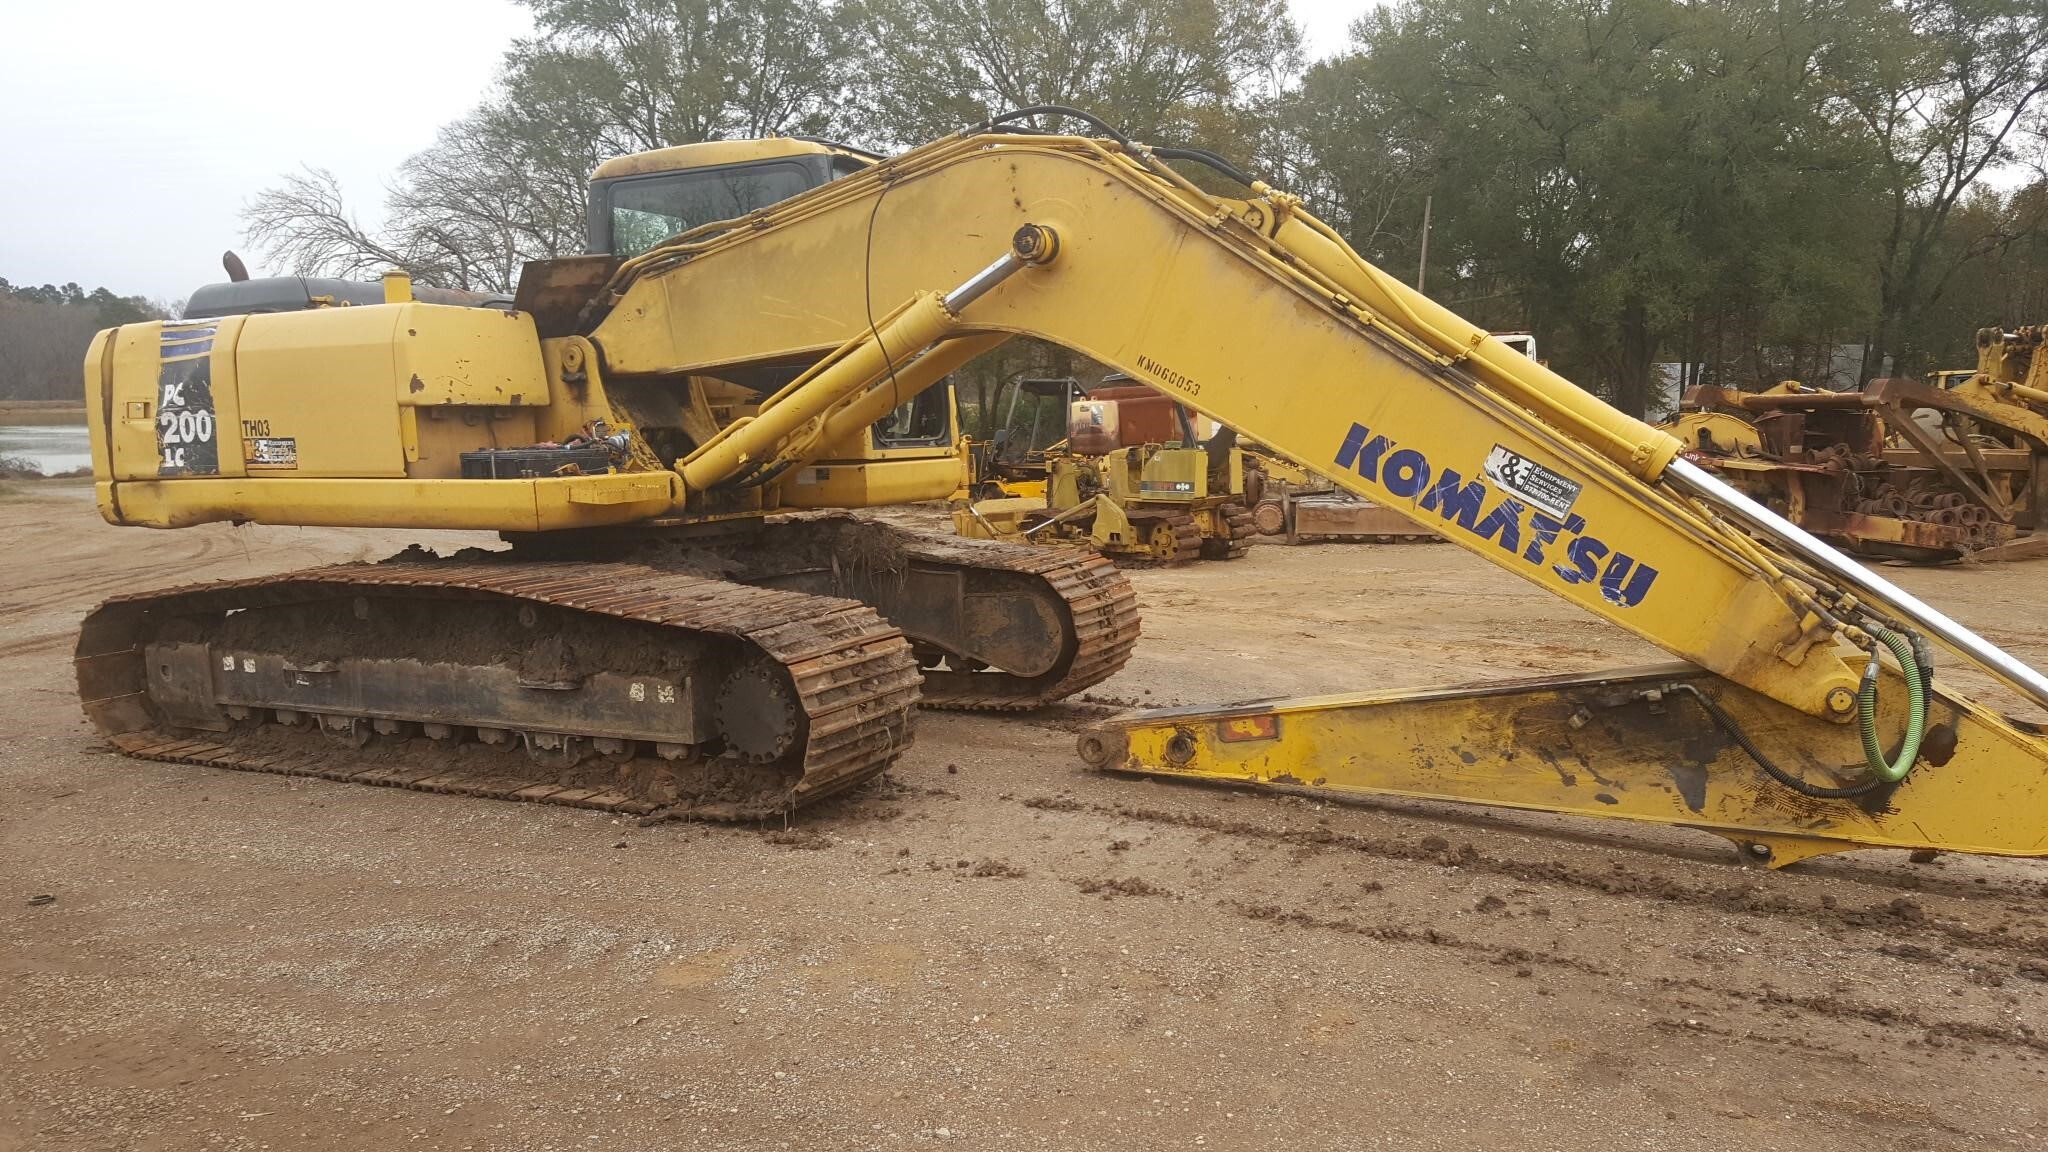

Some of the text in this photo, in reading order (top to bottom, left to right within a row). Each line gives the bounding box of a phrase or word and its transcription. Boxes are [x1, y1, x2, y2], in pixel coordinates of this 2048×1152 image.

[162, 382, 185, 407] PC
[160, 409, 212, 444] 200
[242, 419, 271, 437] TH03
[163, 447, 185, 468] LC
[1333, 421, 1659, 608] KOMATSU
